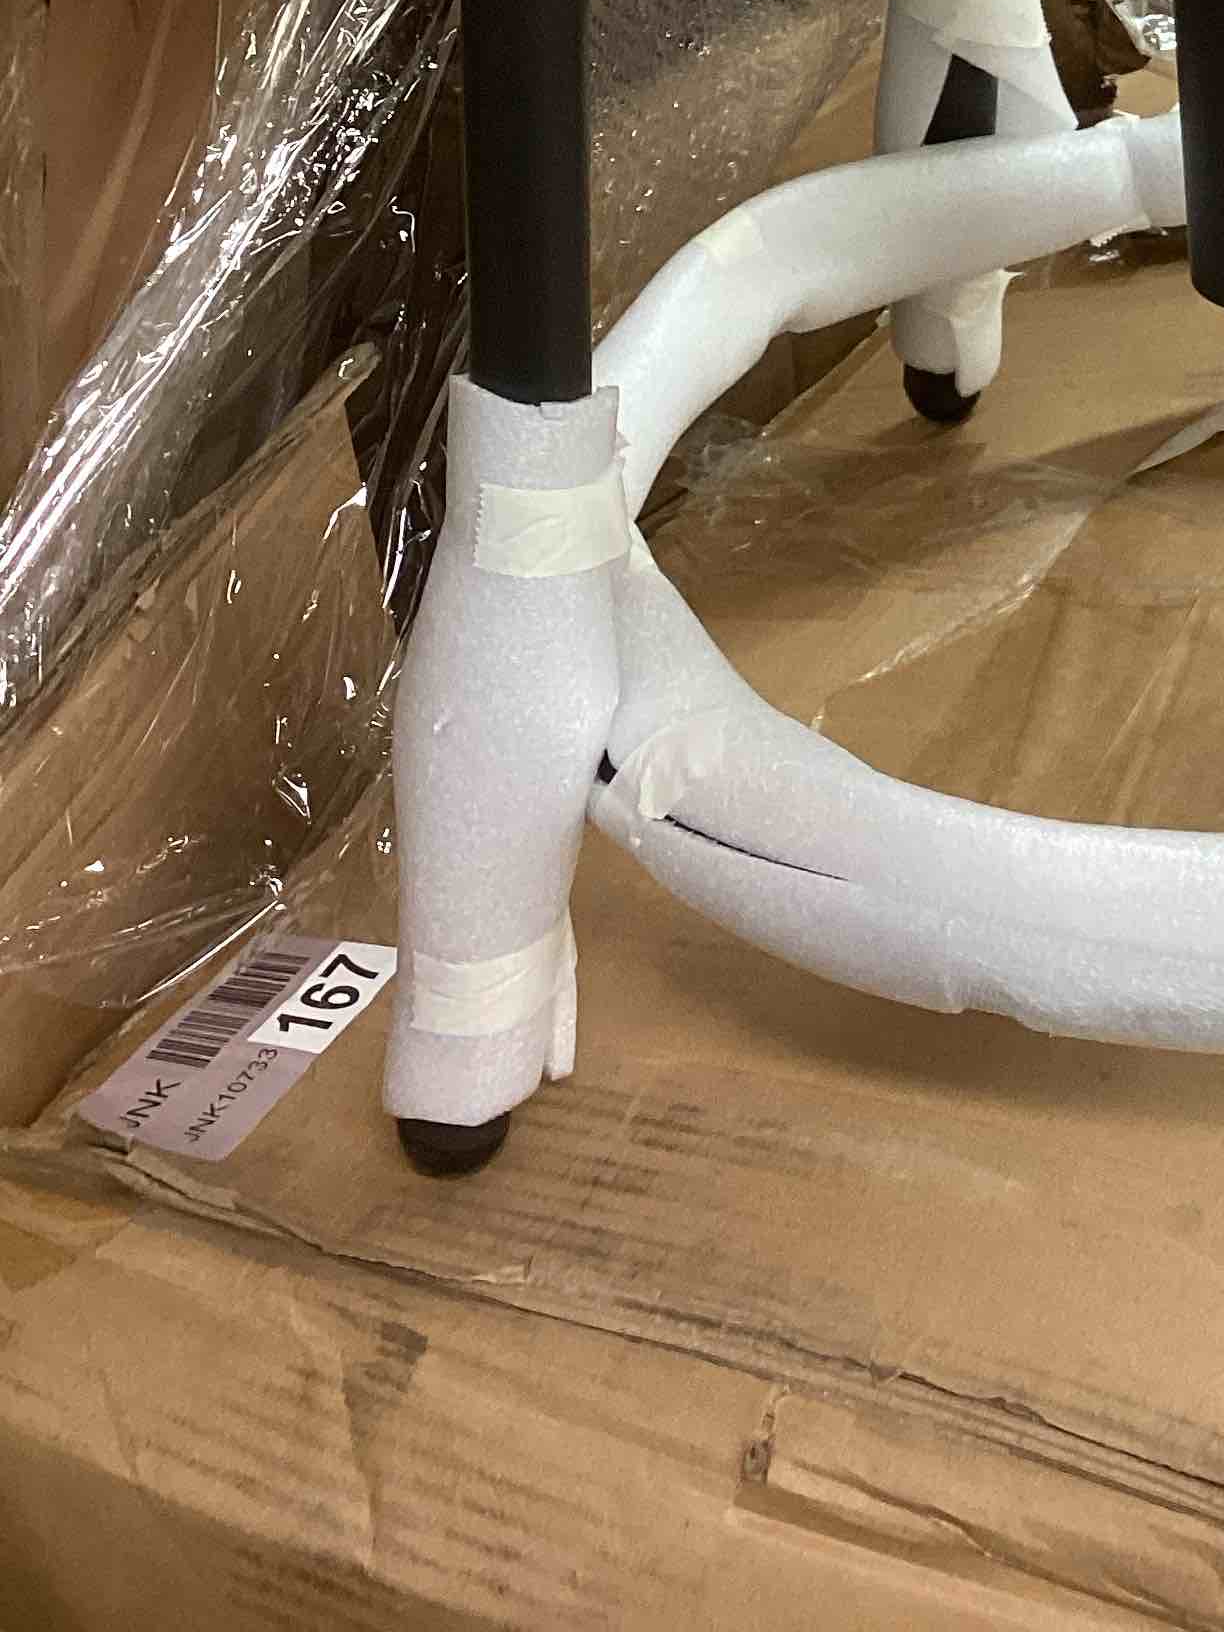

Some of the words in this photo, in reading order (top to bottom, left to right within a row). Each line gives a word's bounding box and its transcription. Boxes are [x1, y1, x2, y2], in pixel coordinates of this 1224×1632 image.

[276, 953, 380, 1033] 167
[119, 1078, 183, 1129] JNK
[184, 1047, 279, 1143] JNK10733
